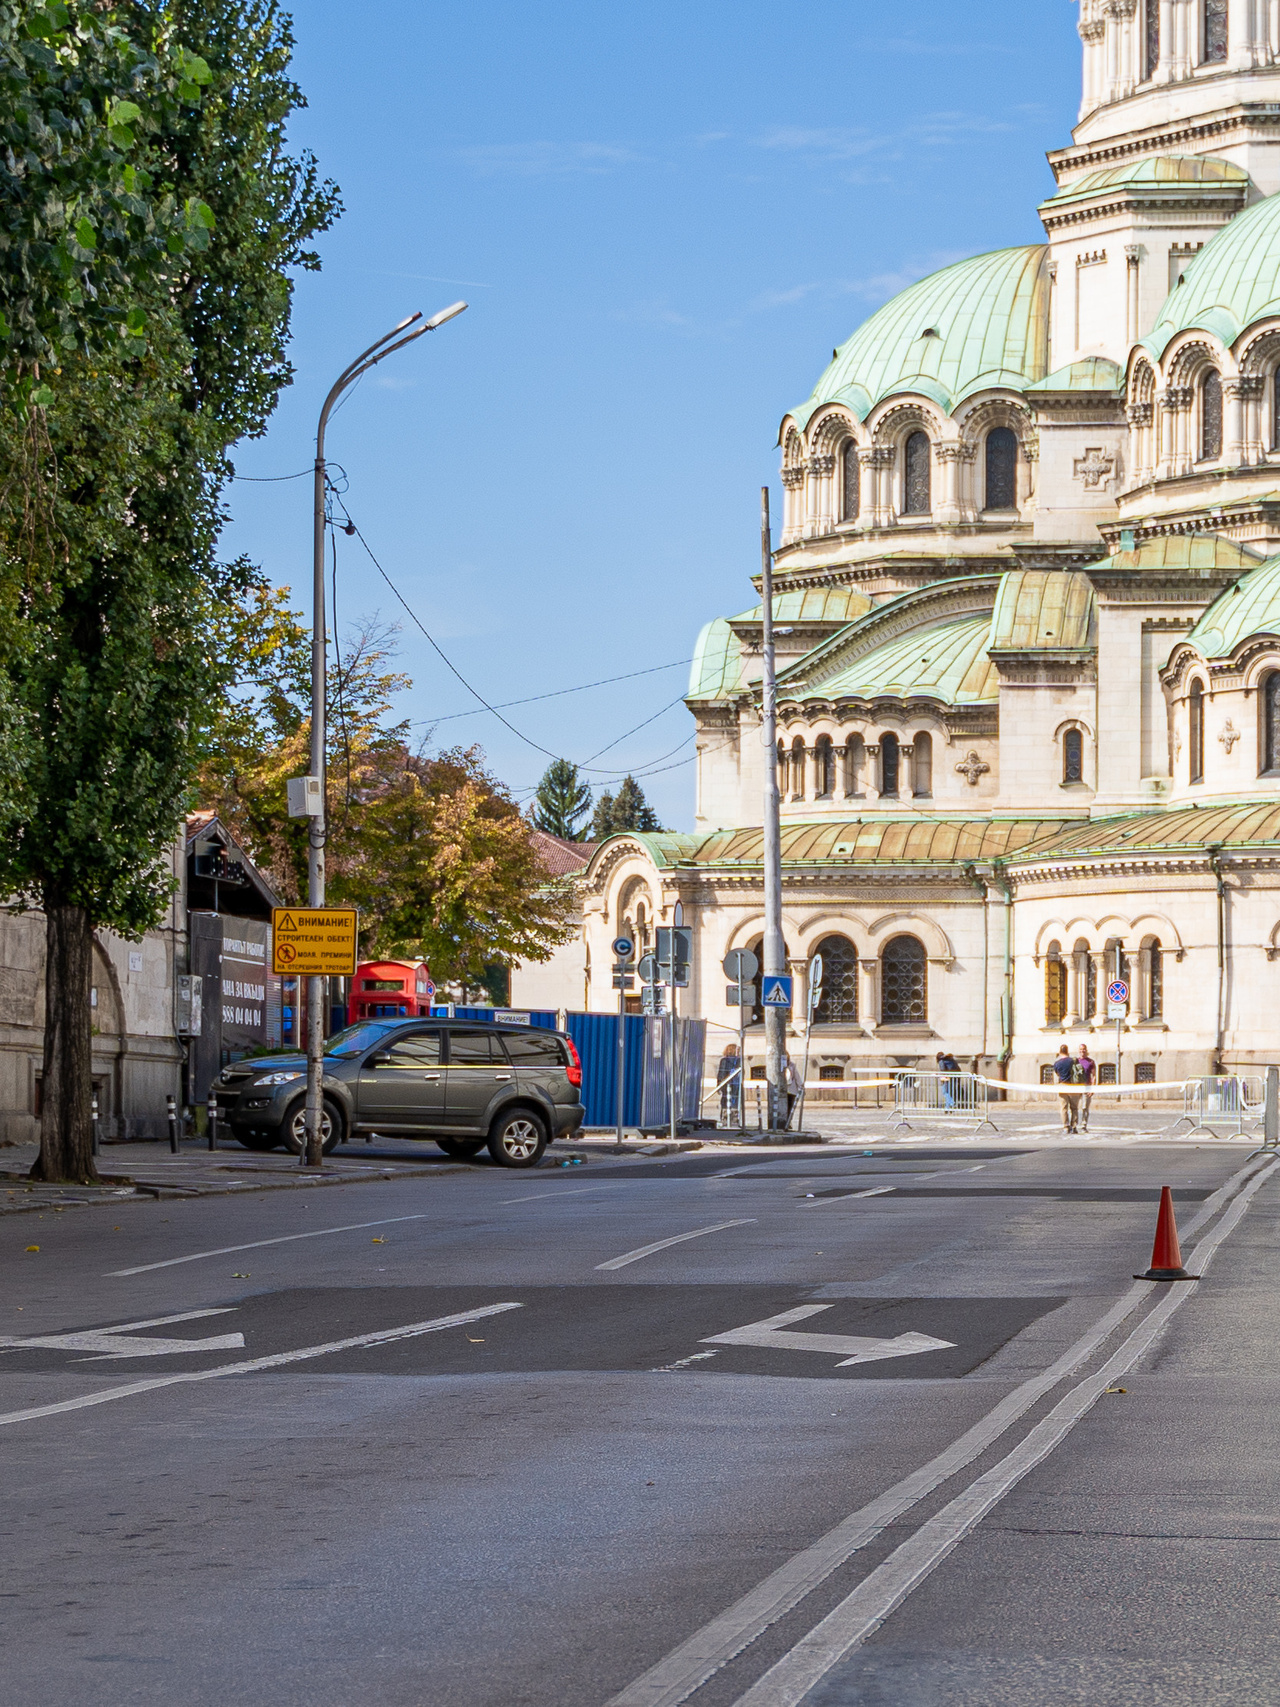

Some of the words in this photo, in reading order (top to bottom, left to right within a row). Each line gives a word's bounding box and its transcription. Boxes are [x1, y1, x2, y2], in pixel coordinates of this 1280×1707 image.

[298, 917, 353, 928] ВНИМАНИЕ!
[277, 934, 324, 942] СТРОИТЕЛЕН
[327, 935, 353, 943] ОБЕКТ!
[235, 981, 243, 998] ЗА
[235, 1007, 244, 1025] 04
[244, 1008, 252, 1026] 04
[253, 1009, 261, 1026] 04
